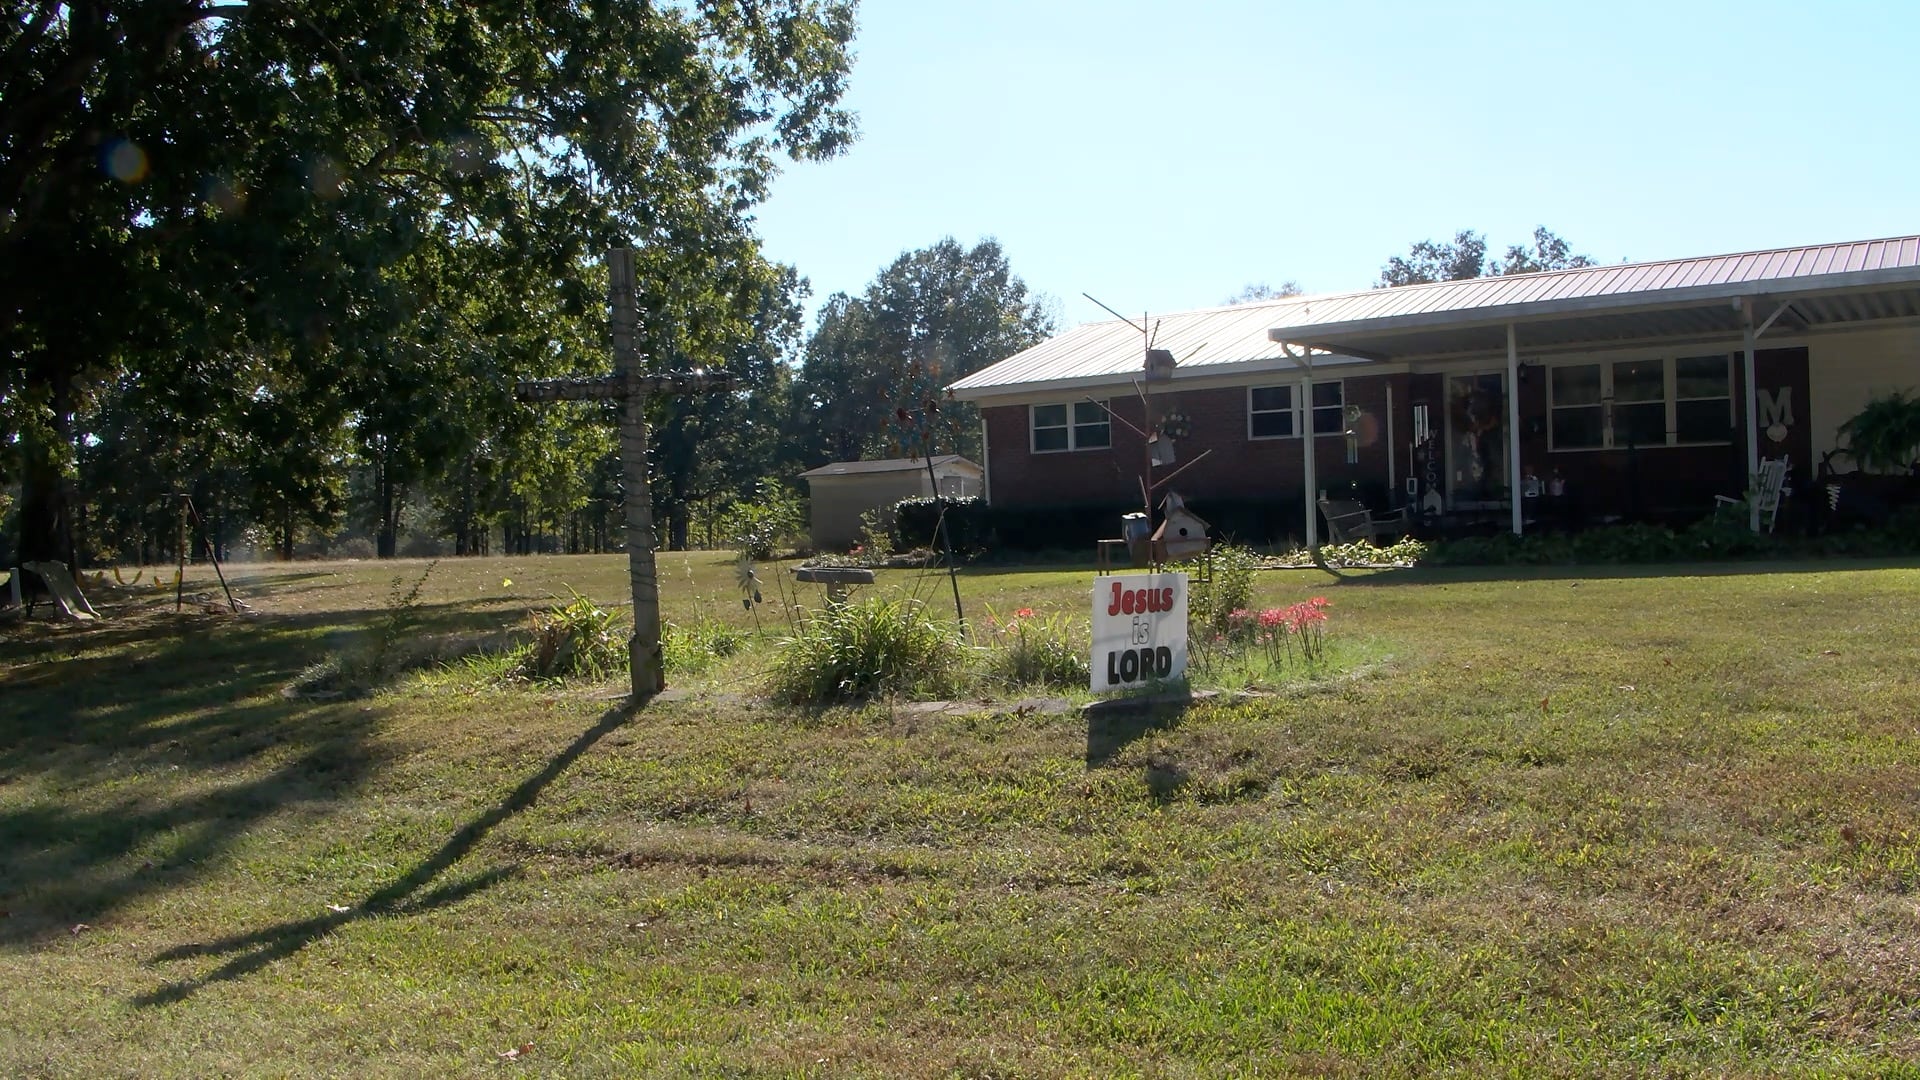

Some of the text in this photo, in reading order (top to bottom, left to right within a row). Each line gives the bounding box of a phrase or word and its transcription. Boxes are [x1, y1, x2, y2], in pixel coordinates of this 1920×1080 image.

[1757, 386, 1794, 427] M
[1425, 428, 1438, 493] WELCOM
[1107, 582, 1174, 616] Jesus
[1132, 616, 1150, 645] is
[1107, 646, 1173, 685] LORD
